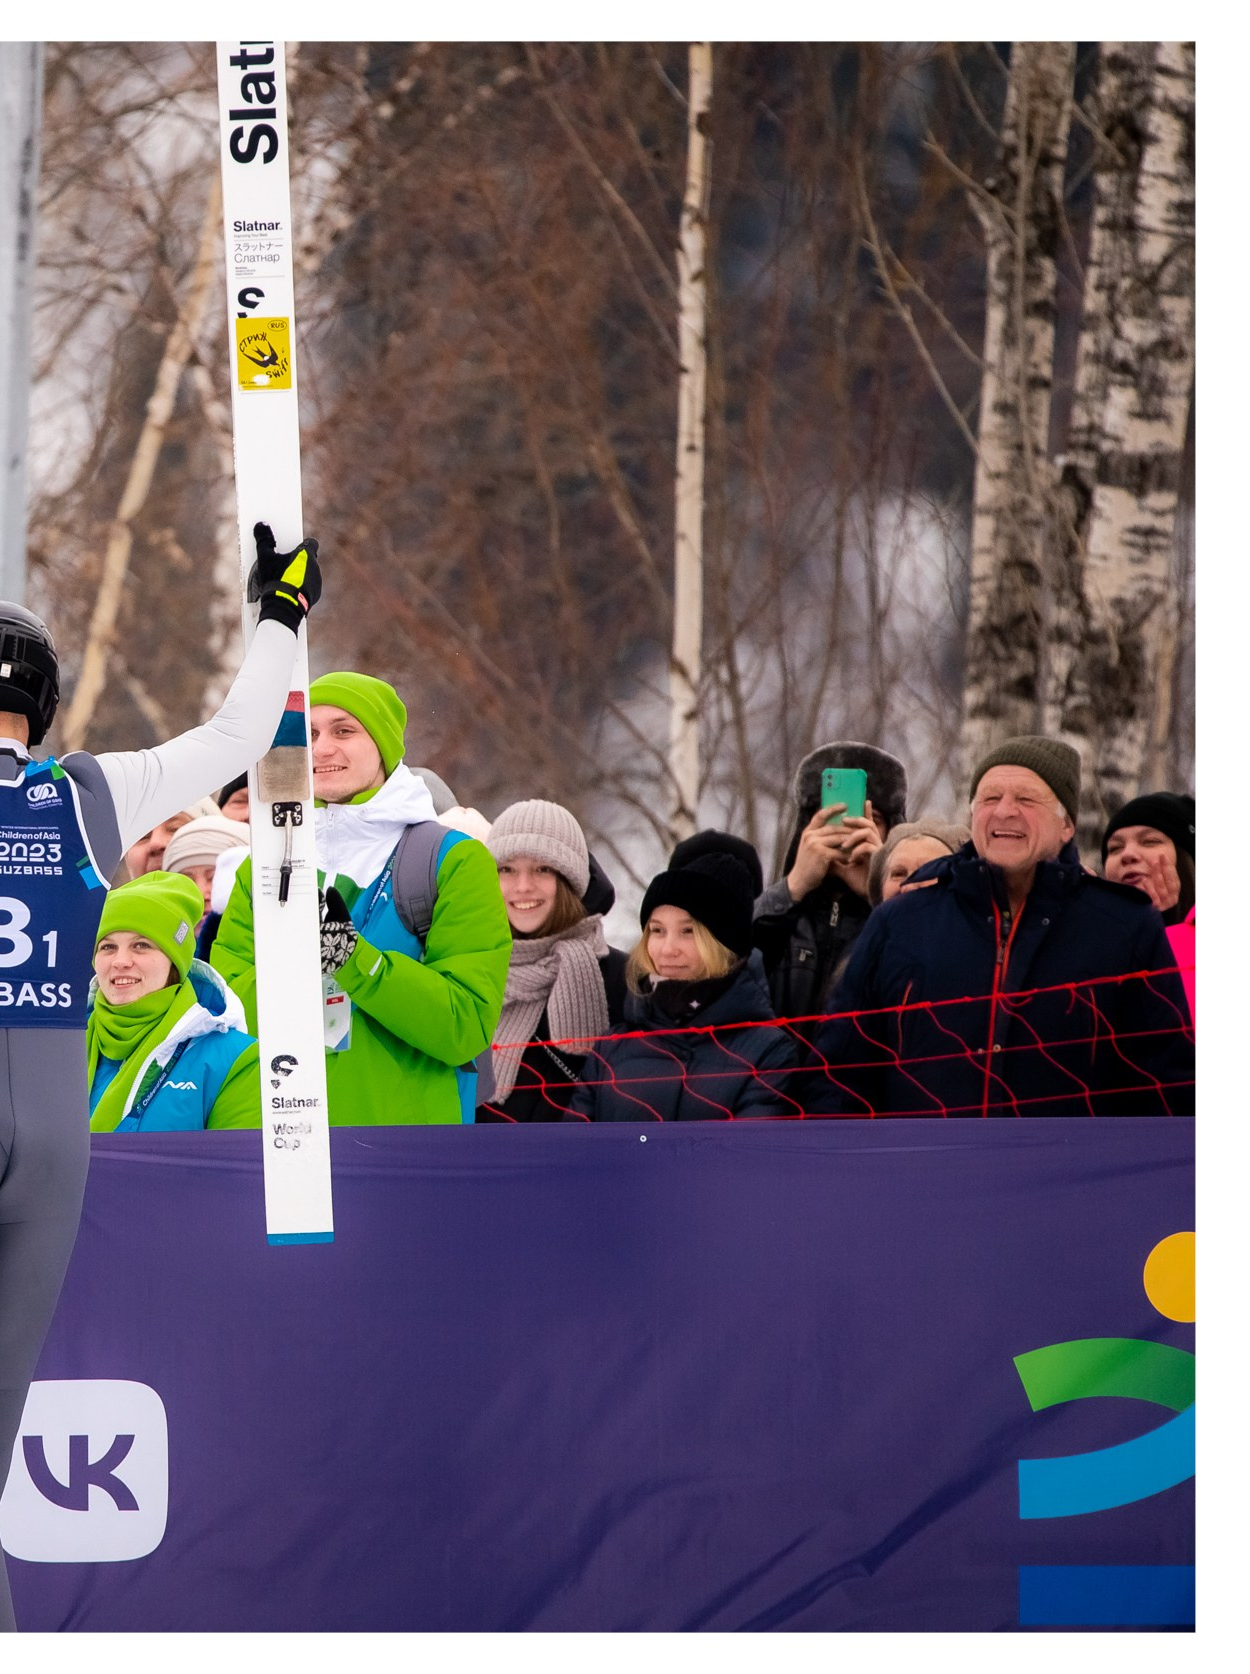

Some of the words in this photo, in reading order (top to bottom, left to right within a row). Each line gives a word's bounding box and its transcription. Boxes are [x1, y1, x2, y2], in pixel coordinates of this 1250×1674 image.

[229, 41, 279, 164] Slat
[233, 220, 280, 232] Slatnar
[235, 242, 283, 252] スラットナー
[234, 253, 280, 264] Слатнар
[239, 331, 268, 353] СТРИЖ
[33, 831, 43, 840] of
[42, 831, 61, 840] Asia
[42, 930, 58, 968] 1
[271, 1097, 319, 1109] Slatnar
